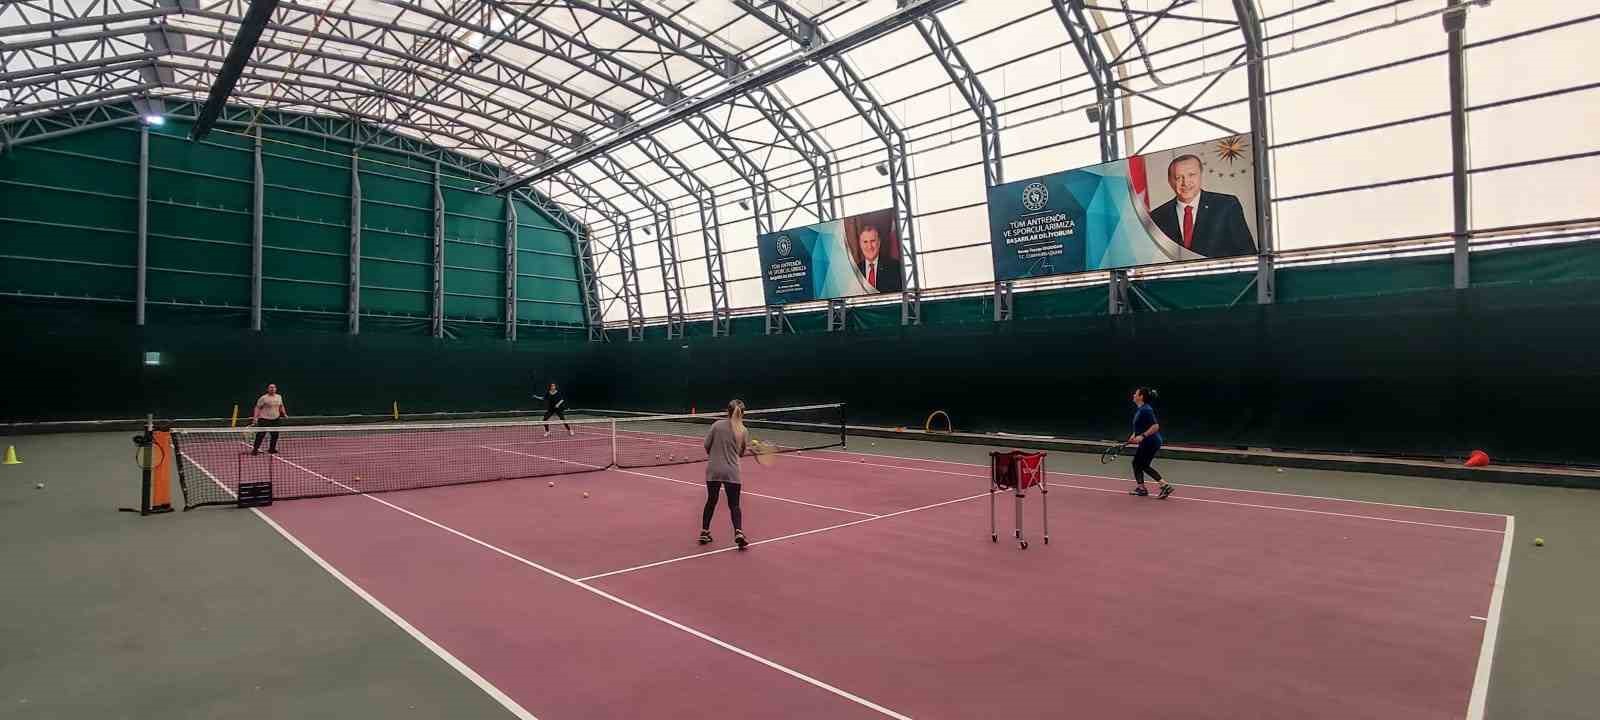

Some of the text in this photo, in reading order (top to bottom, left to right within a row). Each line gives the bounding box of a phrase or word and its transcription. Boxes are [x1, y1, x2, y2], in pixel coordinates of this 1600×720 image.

[1010, 214, 1066, 229] TÜM ANTRENÖR
[1013, 221, 1075, 235] SPORCULARIMIZA
